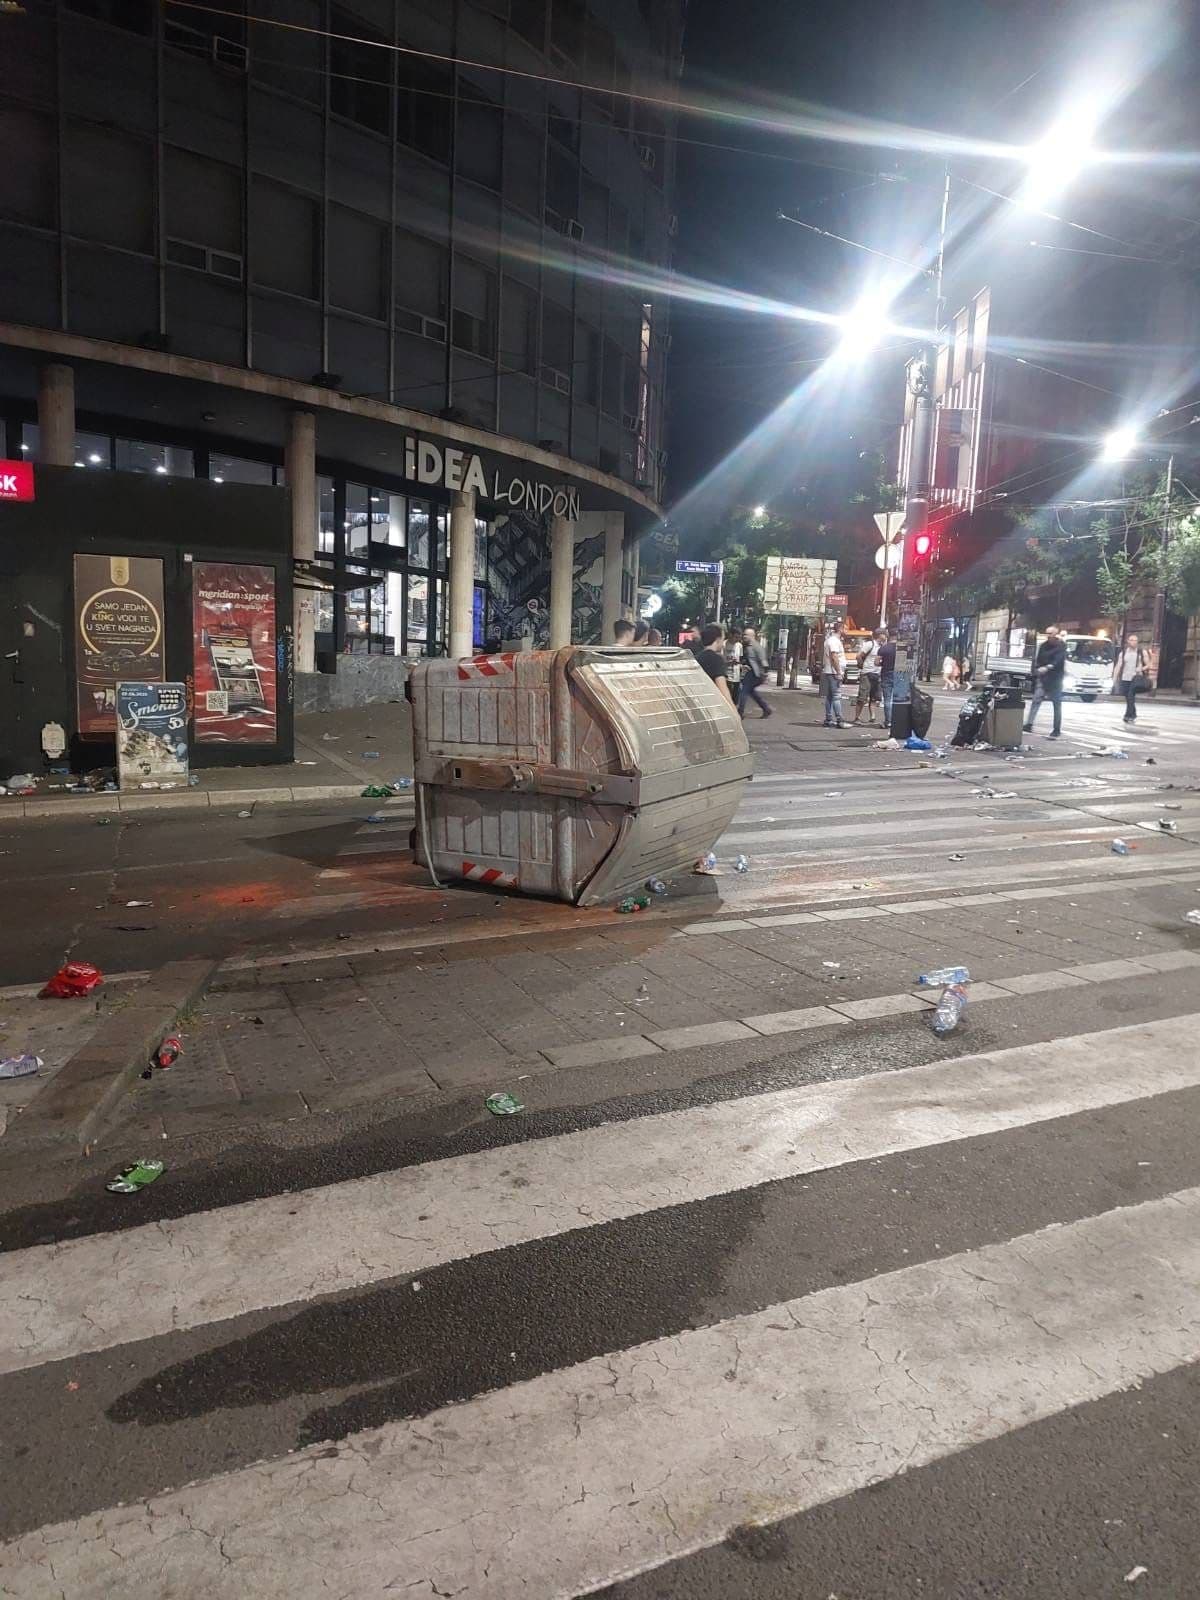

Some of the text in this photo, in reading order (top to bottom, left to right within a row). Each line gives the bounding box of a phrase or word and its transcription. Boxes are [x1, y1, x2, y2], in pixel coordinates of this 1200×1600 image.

[494, 469, 580, 522] LONDON
[94, 602, 148, 611] SAMO JEDAN
[91, 613, 114, 621] KING
[140, 615, 150, 623] TE
[86, 623, 157, 633] U SVET NAGRADA
